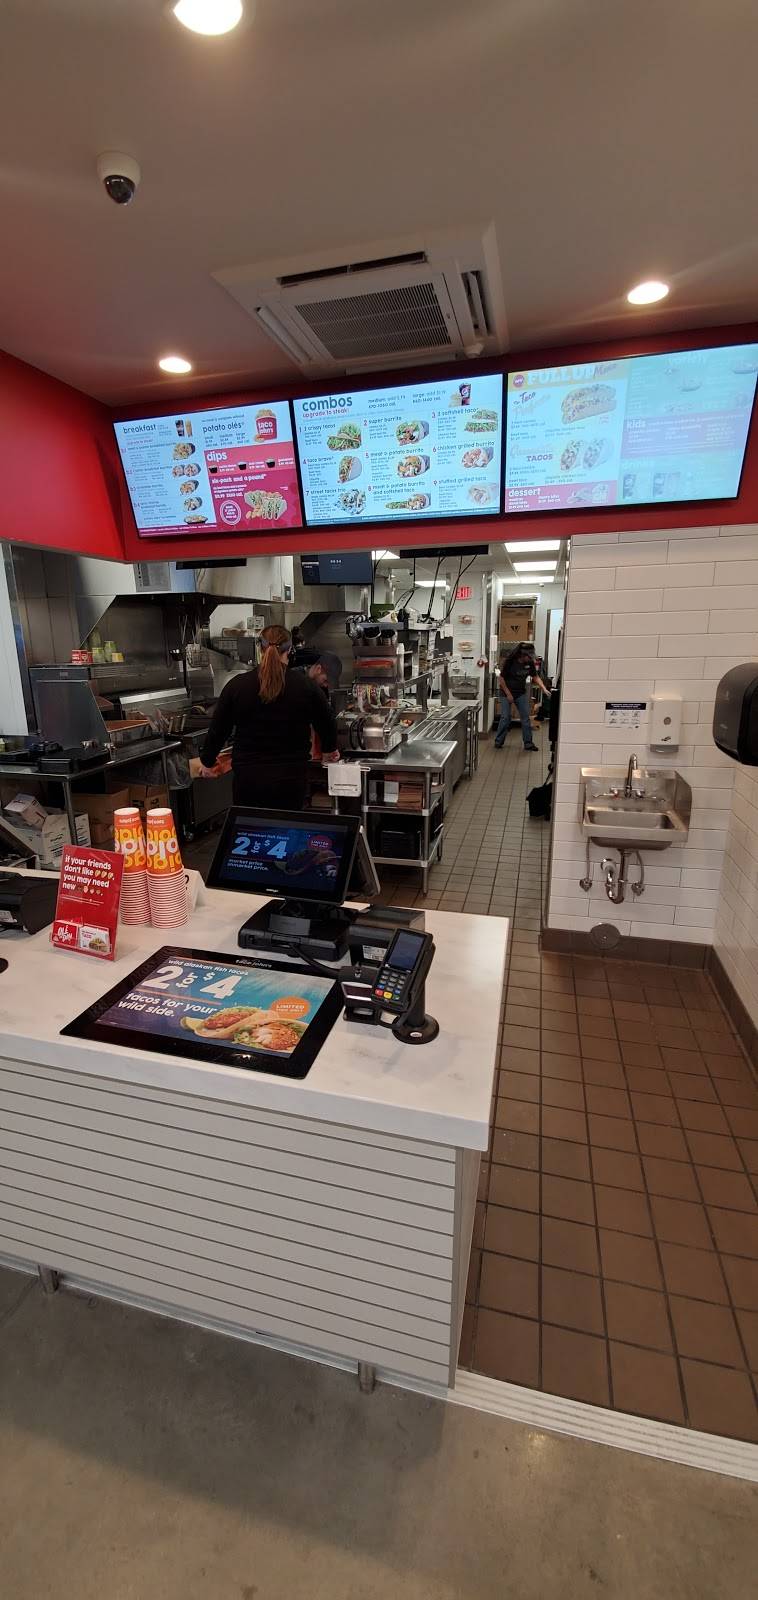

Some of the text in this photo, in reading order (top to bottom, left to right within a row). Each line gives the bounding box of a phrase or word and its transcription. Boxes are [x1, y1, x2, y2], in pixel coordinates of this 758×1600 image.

[302, 396, 353, 412] combos
[303, 411, 326, 419] upgrade
[123, 424, 157, 434] breakfast
[202, 423, 226, 434] potato
[258, 421, 273, 429] taco
[206, 451, 228, 462] dips
[527, 454, 553, 462] TACOS
[509, 488, 541, 498] dessert
[456, 586, 472, 599] EXIT
[231, 836, 288, 859] 2 for $ 4
[71, 857, 87, 866] your
[87, 859, 111, 870] friends
[64, 865, 94, 876] don't like
[62, 882, 76, 890] new
[63, 874, 109, 888] you may need
[183, 962, 214, 970] alaskan
[228, 968, 249, 976] tacos
[141, 965, 242, 999] 2 for $ 4
[117, 998, 175, 1017] wild side.
[126, 992, 218, 1014] tacos for your
